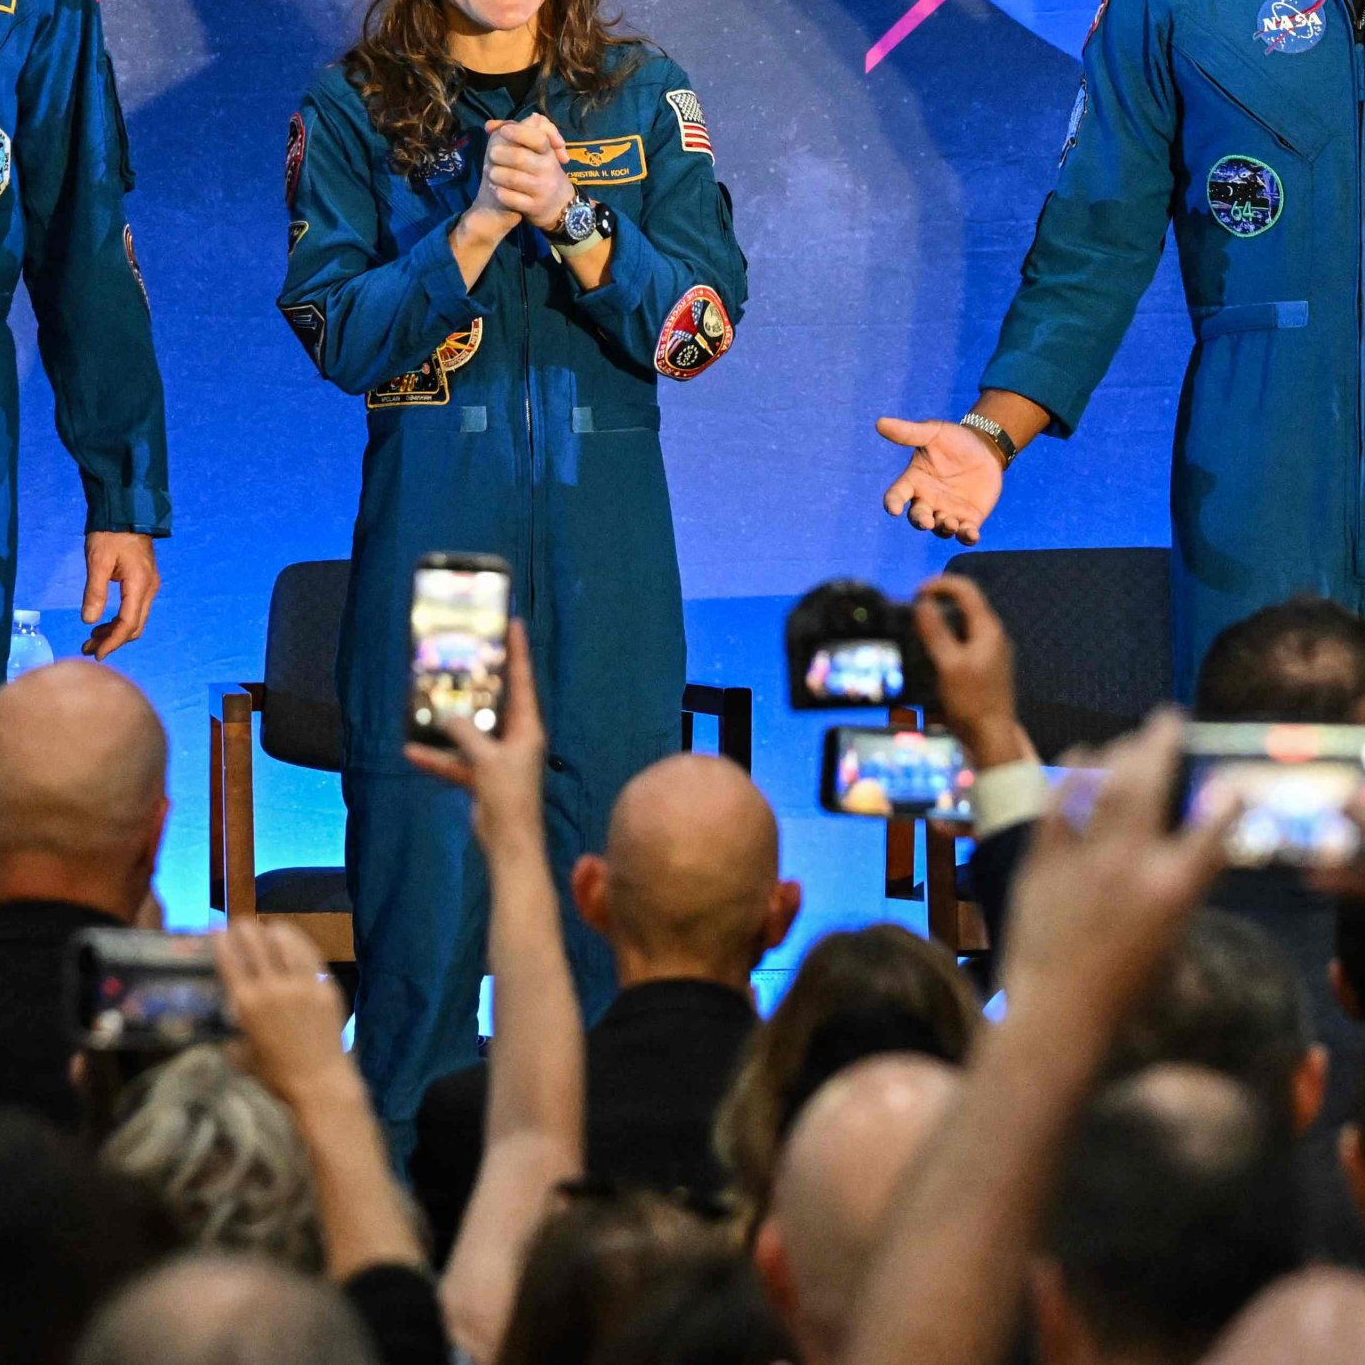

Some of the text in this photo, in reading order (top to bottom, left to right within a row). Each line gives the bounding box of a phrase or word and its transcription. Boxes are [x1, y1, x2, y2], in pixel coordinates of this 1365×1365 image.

[1263, 11, 1322, 32] NASA
[611, 167, 629, 177] KOCH
[1231, 201, 1254, 222] 64
